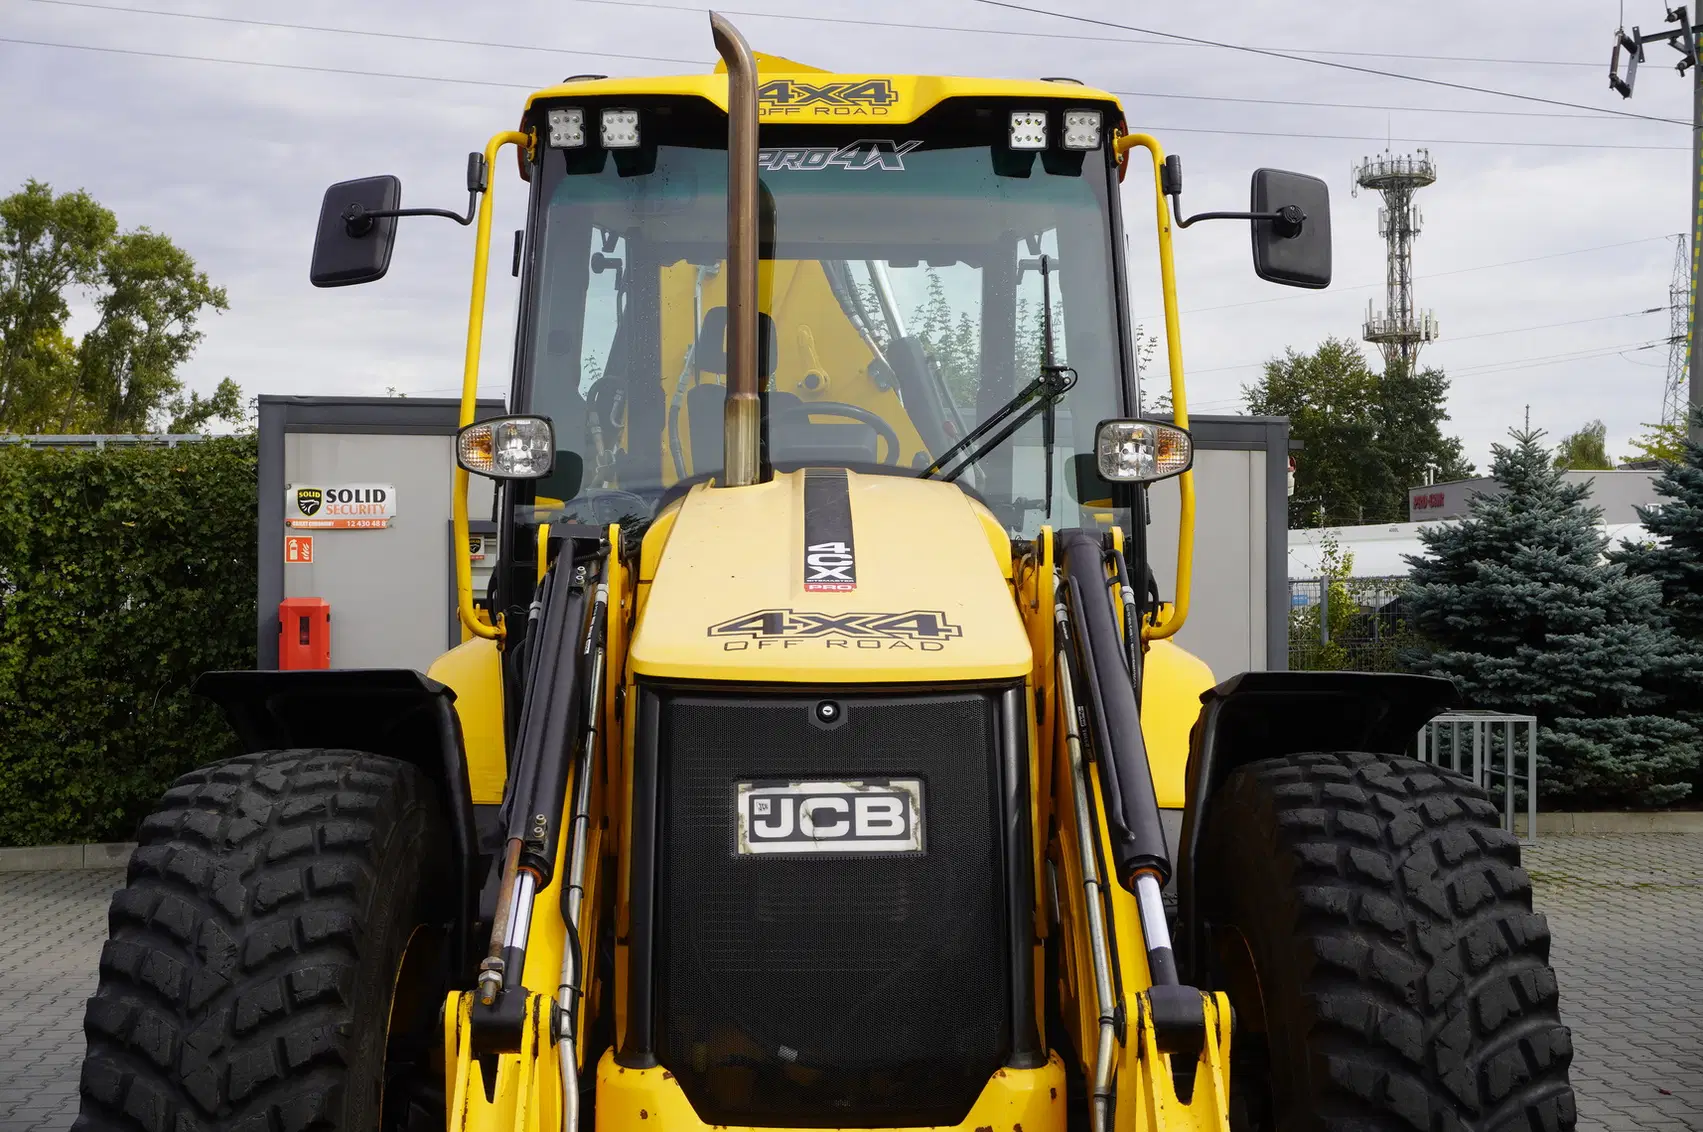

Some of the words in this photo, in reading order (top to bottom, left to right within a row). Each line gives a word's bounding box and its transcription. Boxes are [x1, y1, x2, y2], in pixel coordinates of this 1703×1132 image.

[814, 107, 888, 116] ROAD
[298, 490, 321, 498] SOLID
[326, 489, 386, 503] SOLID
[326, 503, 386, 515] SECURITY
[807, 542, 853, 579] 4CX
[724, 639, 804, 651] OFF
[826, 639, 944, 651] ROAD
[754, 797, 905, 838] JCB
